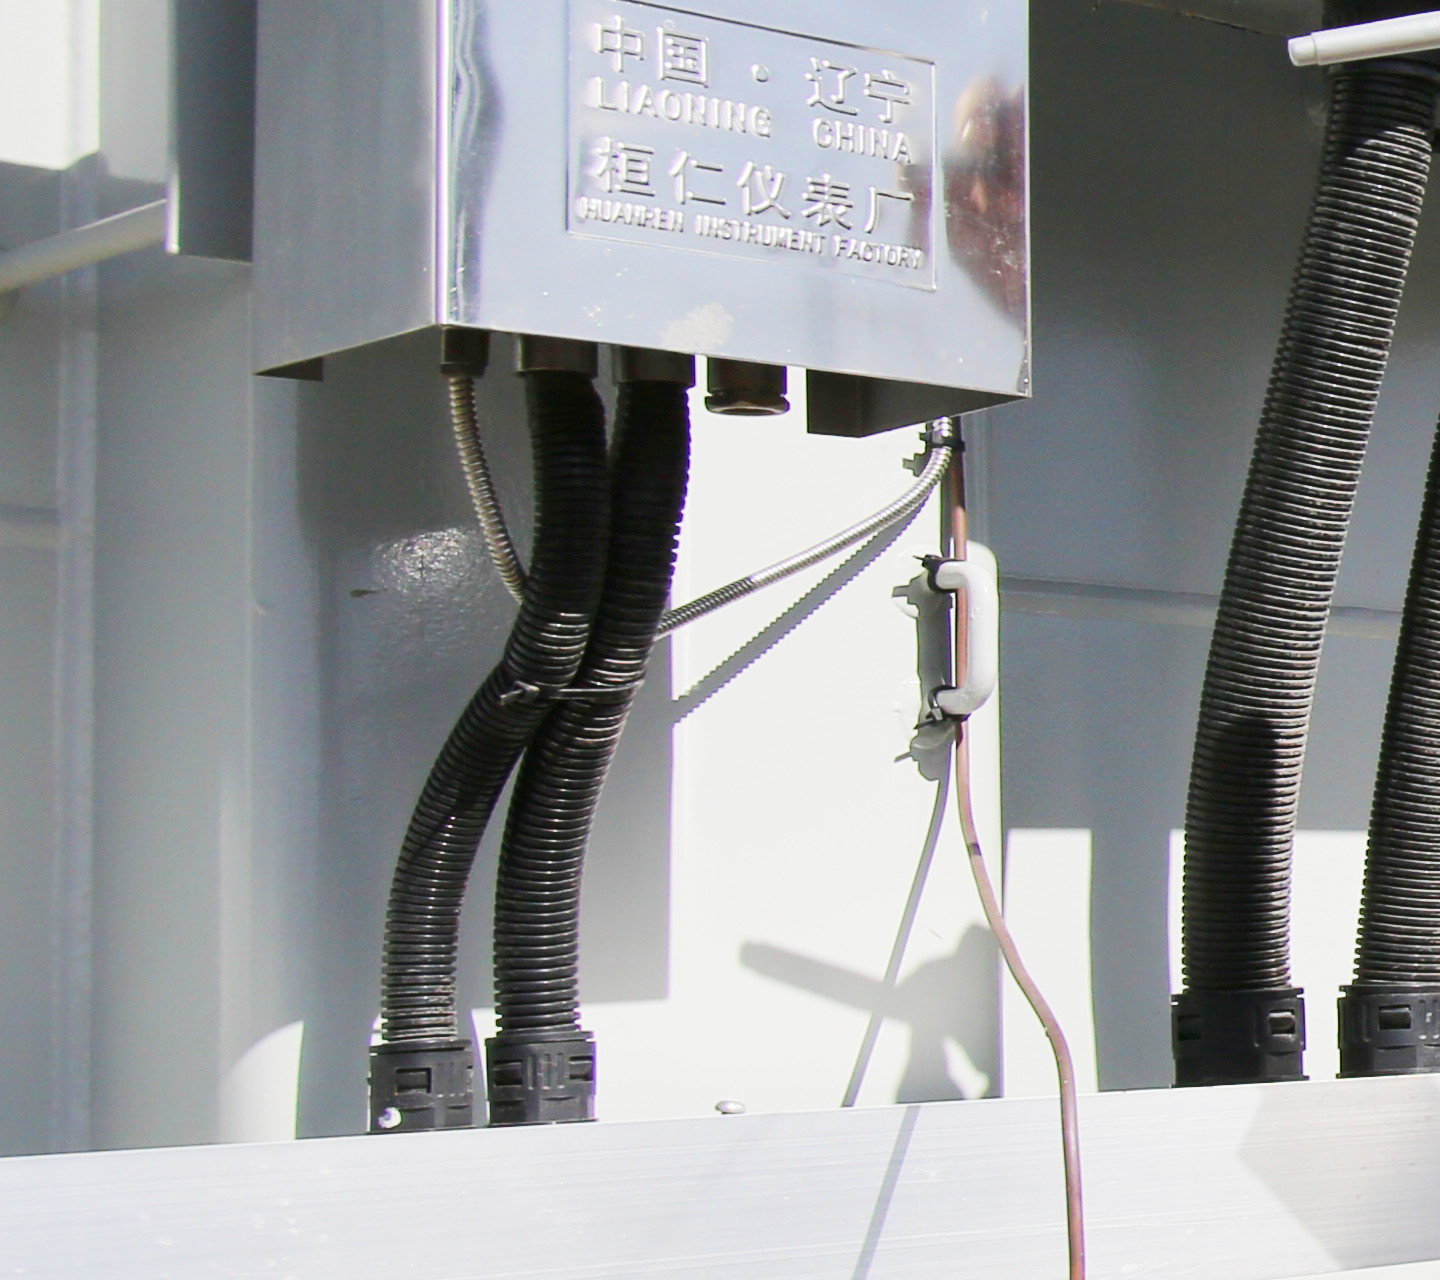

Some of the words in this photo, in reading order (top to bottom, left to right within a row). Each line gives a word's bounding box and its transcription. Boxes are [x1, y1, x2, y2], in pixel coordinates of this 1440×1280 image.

[594, 75, 772, 139] LIAONING
[812, 116, 913, 164] CHINA
[594, 135, 915, 235] 桓仁仪表厂
[577, 196, 685, 234] HUANREN
[694, 212, 828, 256] INSTRUMENT
[833, 233, 925, 270] FACTORY
